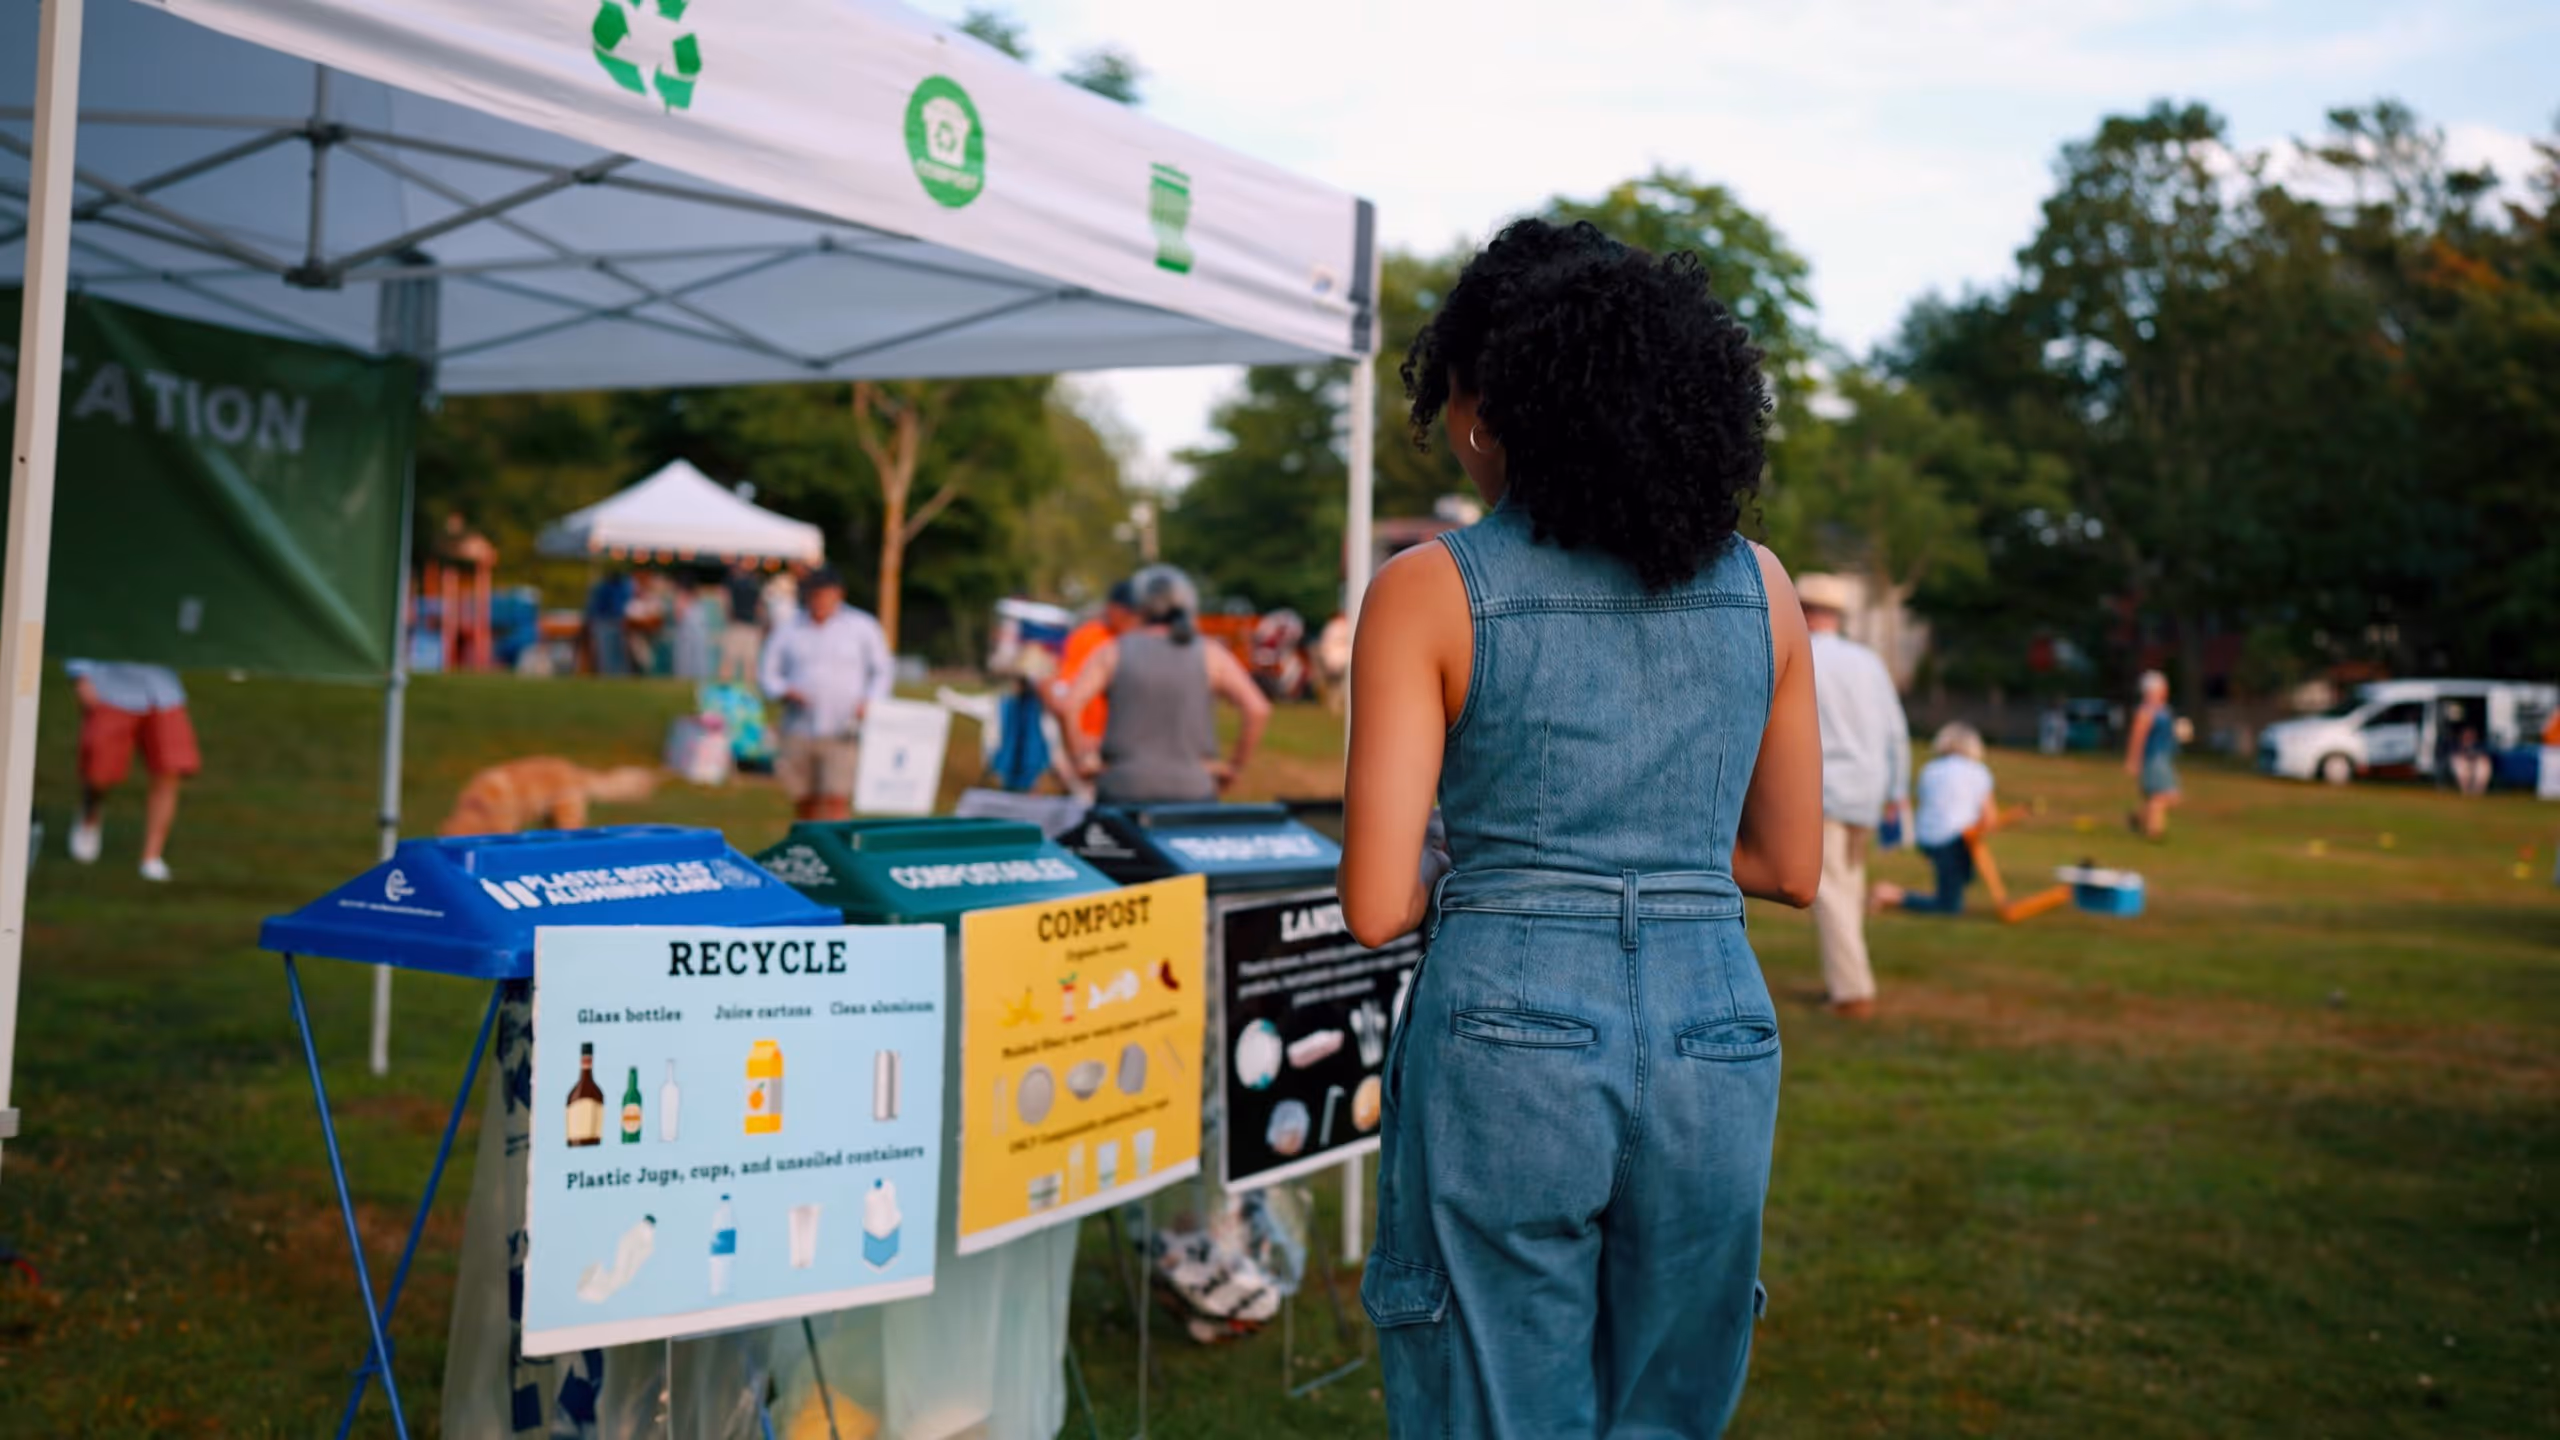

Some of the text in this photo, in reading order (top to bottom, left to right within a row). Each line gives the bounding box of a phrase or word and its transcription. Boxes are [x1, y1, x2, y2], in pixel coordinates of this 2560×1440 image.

[0, 341, 309, 455] ATION
[1038, 896, 1152, 942] COMPOST
[668, 940, 848, 976] RECYCLE
[578, 1006, 682, 1024] Glass bottles
[714, 1004, 812, 1020] Juice cartons
[830, 999, 935, 1015] Clean aluminum
[567, 1145, 924, 1190] Plastic Jugs, cups, and unsoiled containers
